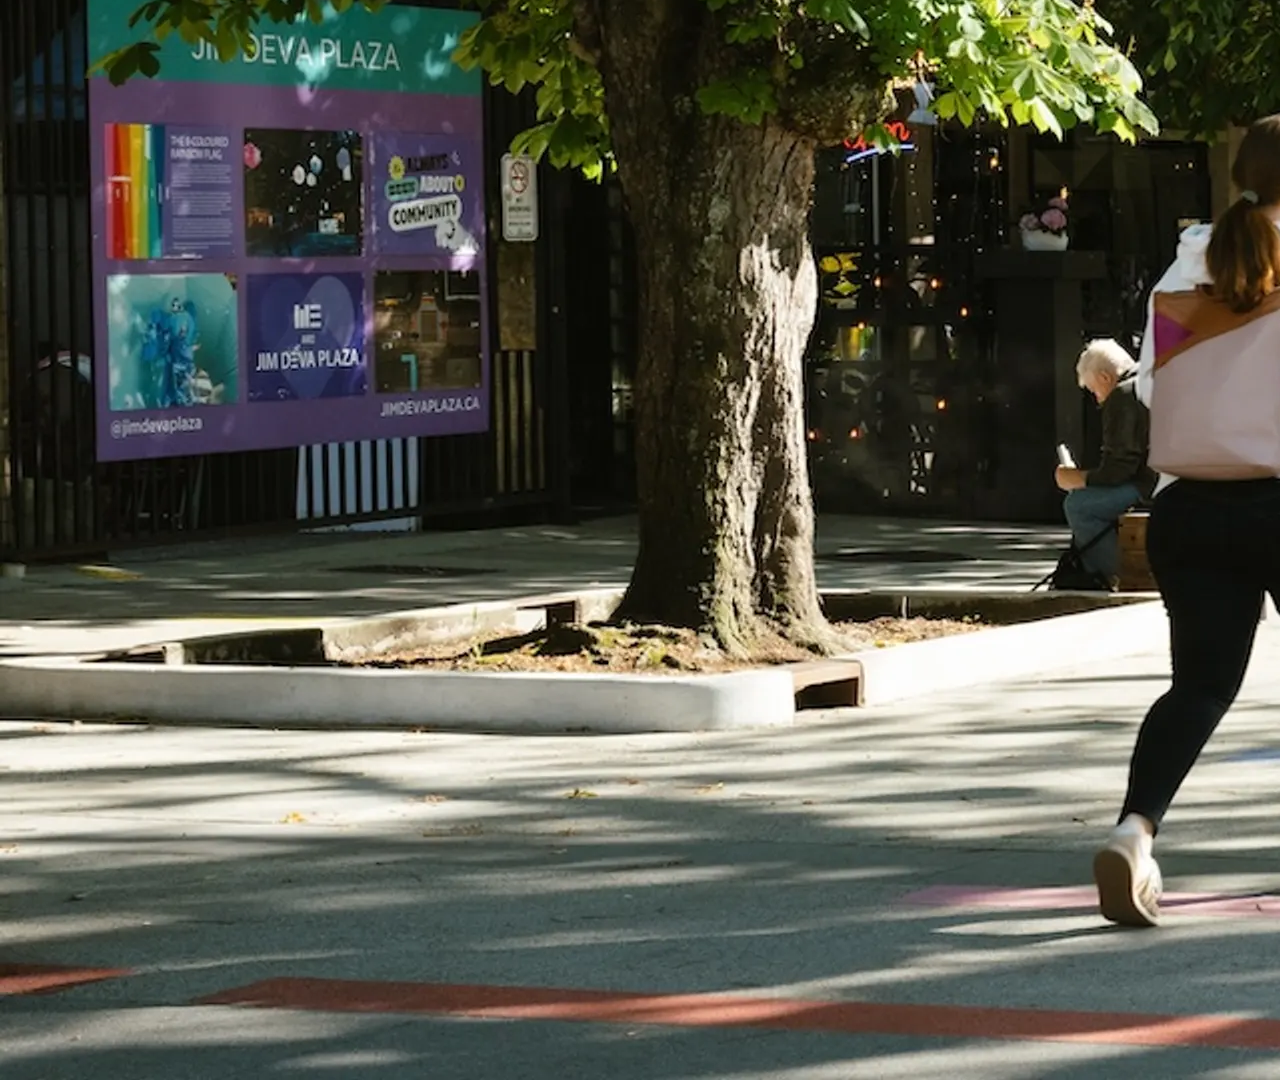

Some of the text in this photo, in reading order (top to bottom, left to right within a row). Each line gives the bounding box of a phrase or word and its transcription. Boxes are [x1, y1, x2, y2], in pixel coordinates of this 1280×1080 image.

[320, 38, 400, 71] PLAZA
[420, 175, 454, 192] ABOUT
[393, 200, 457, 225] COMMUNITY
[256, 348, 359, 371] JIM DEVA PLAZA
[380, 396, 480, 417] JIMDEVAPLAZA.CA
[110, 416, 203, 439] @jimdevaplaza
